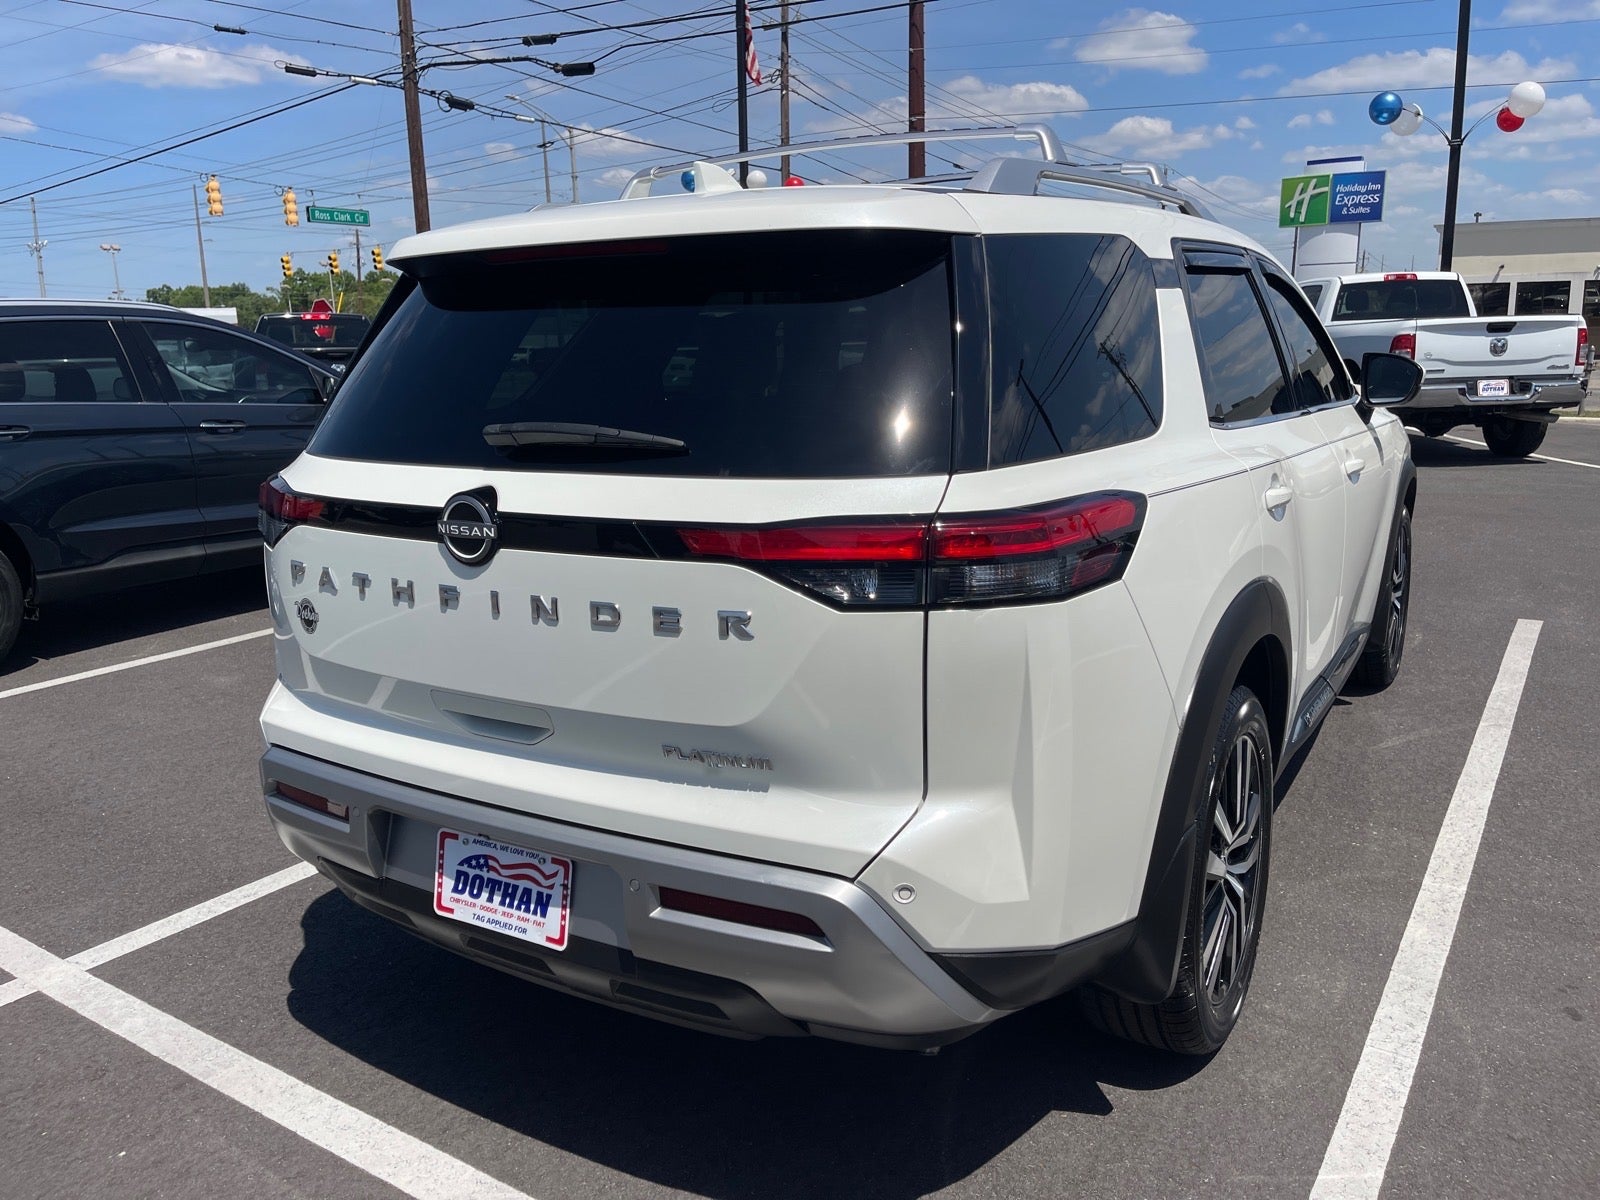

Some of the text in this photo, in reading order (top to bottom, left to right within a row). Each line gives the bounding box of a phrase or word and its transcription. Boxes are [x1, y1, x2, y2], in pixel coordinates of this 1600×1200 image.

[1336, 182, 1381, 193] Holiday Inn
[1335, 193, 1380, 207] Express
[1342, 206, 1371, 215] & Suites
[314, 210, 364, 223] Ross Clark Cir
[437, 523, 495, 537] NISSAN
[290, 558, 754, 641] PATHFINDER
[661, 743, 774, 771] PLATINUM
[471, 838, 540, 860] AMERICA, WE LOVE YOU!
[451, 869, 553, 919] DOTHAN
[449, 896, 546, 928] CHRYSLER DODGE JEEP RAM FIAT
[472, 913, 485, 923] TAG
[485, 915, 513, 931] APPLIED
[513, 925, 528, 935] FOR
